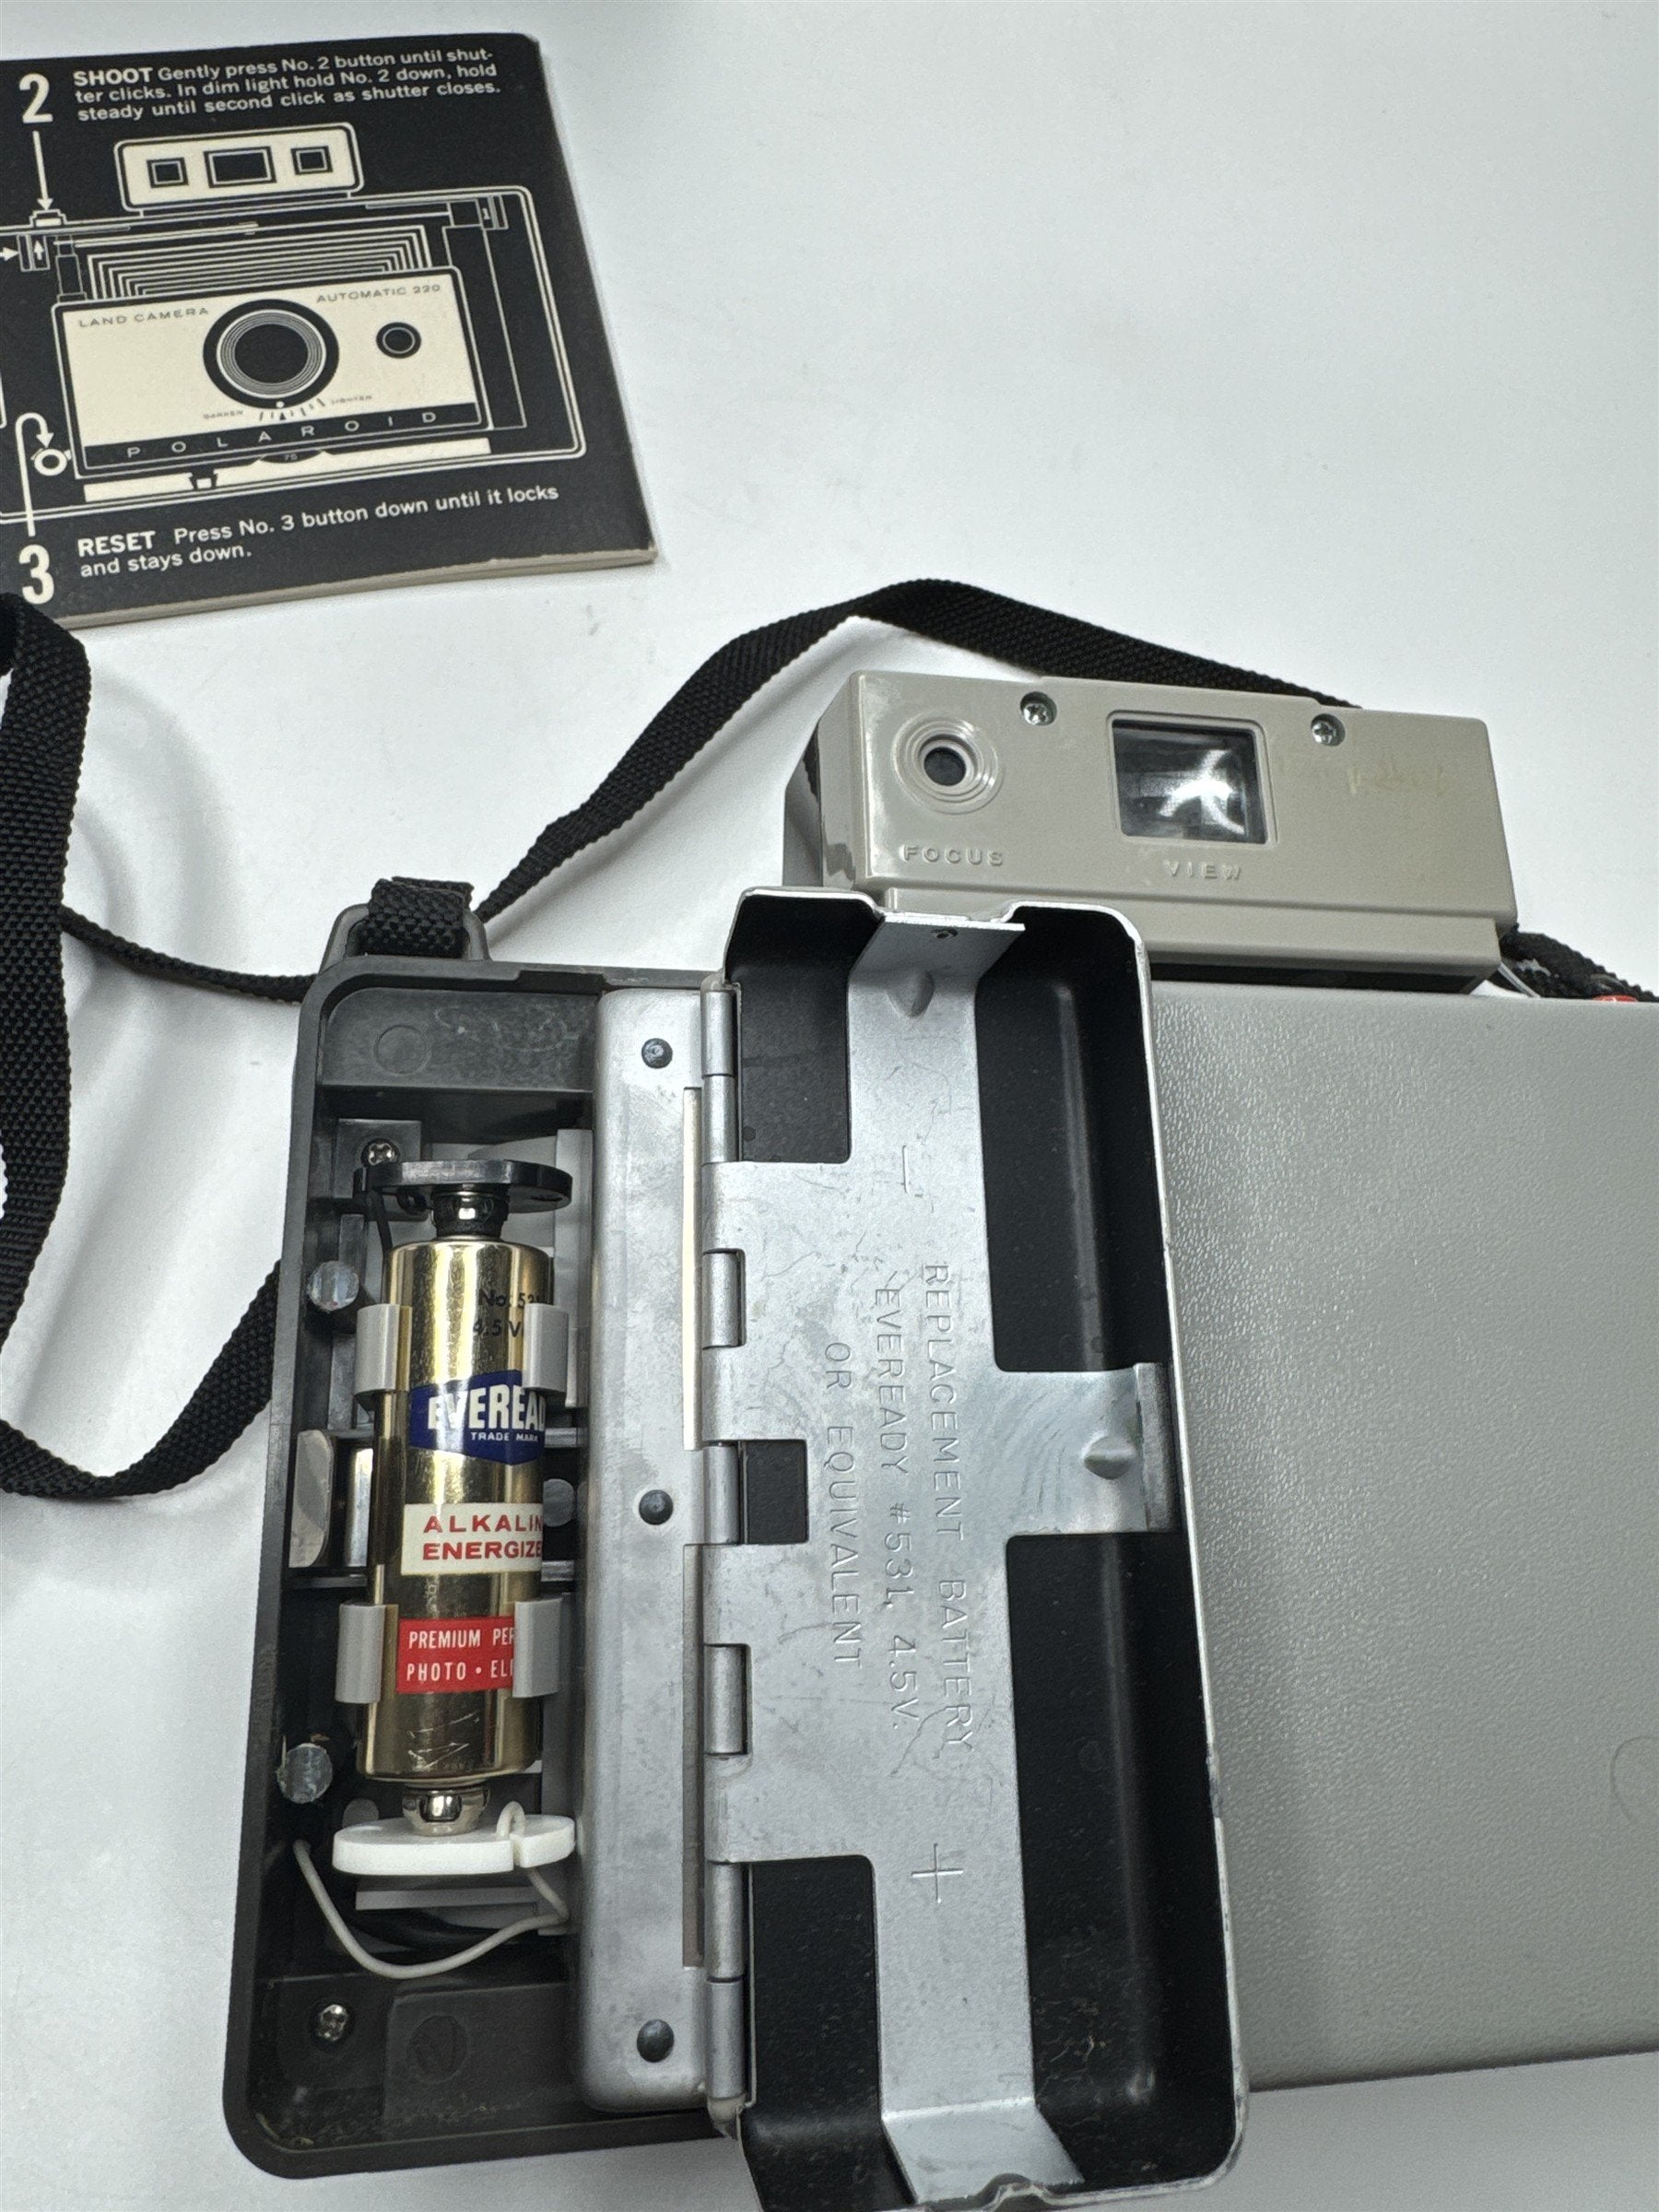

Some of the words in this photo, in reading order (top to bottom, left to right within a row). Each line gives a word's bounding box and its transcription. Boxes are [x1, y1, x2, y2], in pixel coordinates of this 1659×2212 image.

[74, 66, 153, 87] SHOOT
[158, 64, 220, 83] Gently
[226, 62, 277, 79] press
[281, 58, 314, 73] No.
[318, 56, 330, 70] 2
[335, 51, 395, 68] button
[400, 50, 442, 65] until
[446, 47, 493, 63] shut-
[75, 88, 102, 103] ter
[109, 85, 171, 101] clicks.
[178, 83, 196, 97] In
[202, 80, 239, 96] dim
[245, 76, 288, 93] light
[294, 73, 335, 88] hold
[341, 71, 372, 86] No.
[377, 69, 390, 82] 2
[396, 67, 452, 82] down,
[457, 64, 497, 77] hold
[18, 72, 53, 125] 2
[77, 103, 144, 122] steady
[152, 100, 196, 117] until
[204, 94, 273, 113] second
[280, 91, 325, 108] click
[333, 90, 356, 103] as
[361, 84, 430, 101] shutter
[436, 80, 501, 97] closes.
[317, 287, 406, 303] AUTOMATIC
[413, 284, 441, 294] 220
[78, 315, 127, 328] LAND
[135, 307, 208, 323] CAMERA
[126, 411, 437, 459] POLAROID
[77, 530, 156, 557] RESET
[173, 525, 232, 544] Press
[239, 519, 275, 536] No.
[280, 514, 295, 531] 3
[301, 506, 369, 528] button
[374, 499, 429, 518] down
[435, 490, 481, 512] until
[487, 488, 503, 505] it
[507, 485, 559, 503] locks
[18, 545, 55, 605] 3
[80, 557, 121, 577] and
[127, 552, 183, 572] stays
[189, 544, 253, 564] down.
[900, 845, 1003, 865] FOCUS
[1163, 860, 1241, 880] VIEW
[825, 1342, 853, 1389] OR
[876, 1288, 908, 1474] EVEREADY
[925, 1265, 964, 1541] REPLACEMENT
[470, 1431, 510, 1441] TRADE
[516, 1432, 538, 1442] MARK
[824, 1426, 862, 1668] EQUIVALENT
[408, 1629, 481, 1650] PREMIUM
[406, 1662, 466, 1681] PHOTO
[939, 1580, 974, 1751] BATTERY
